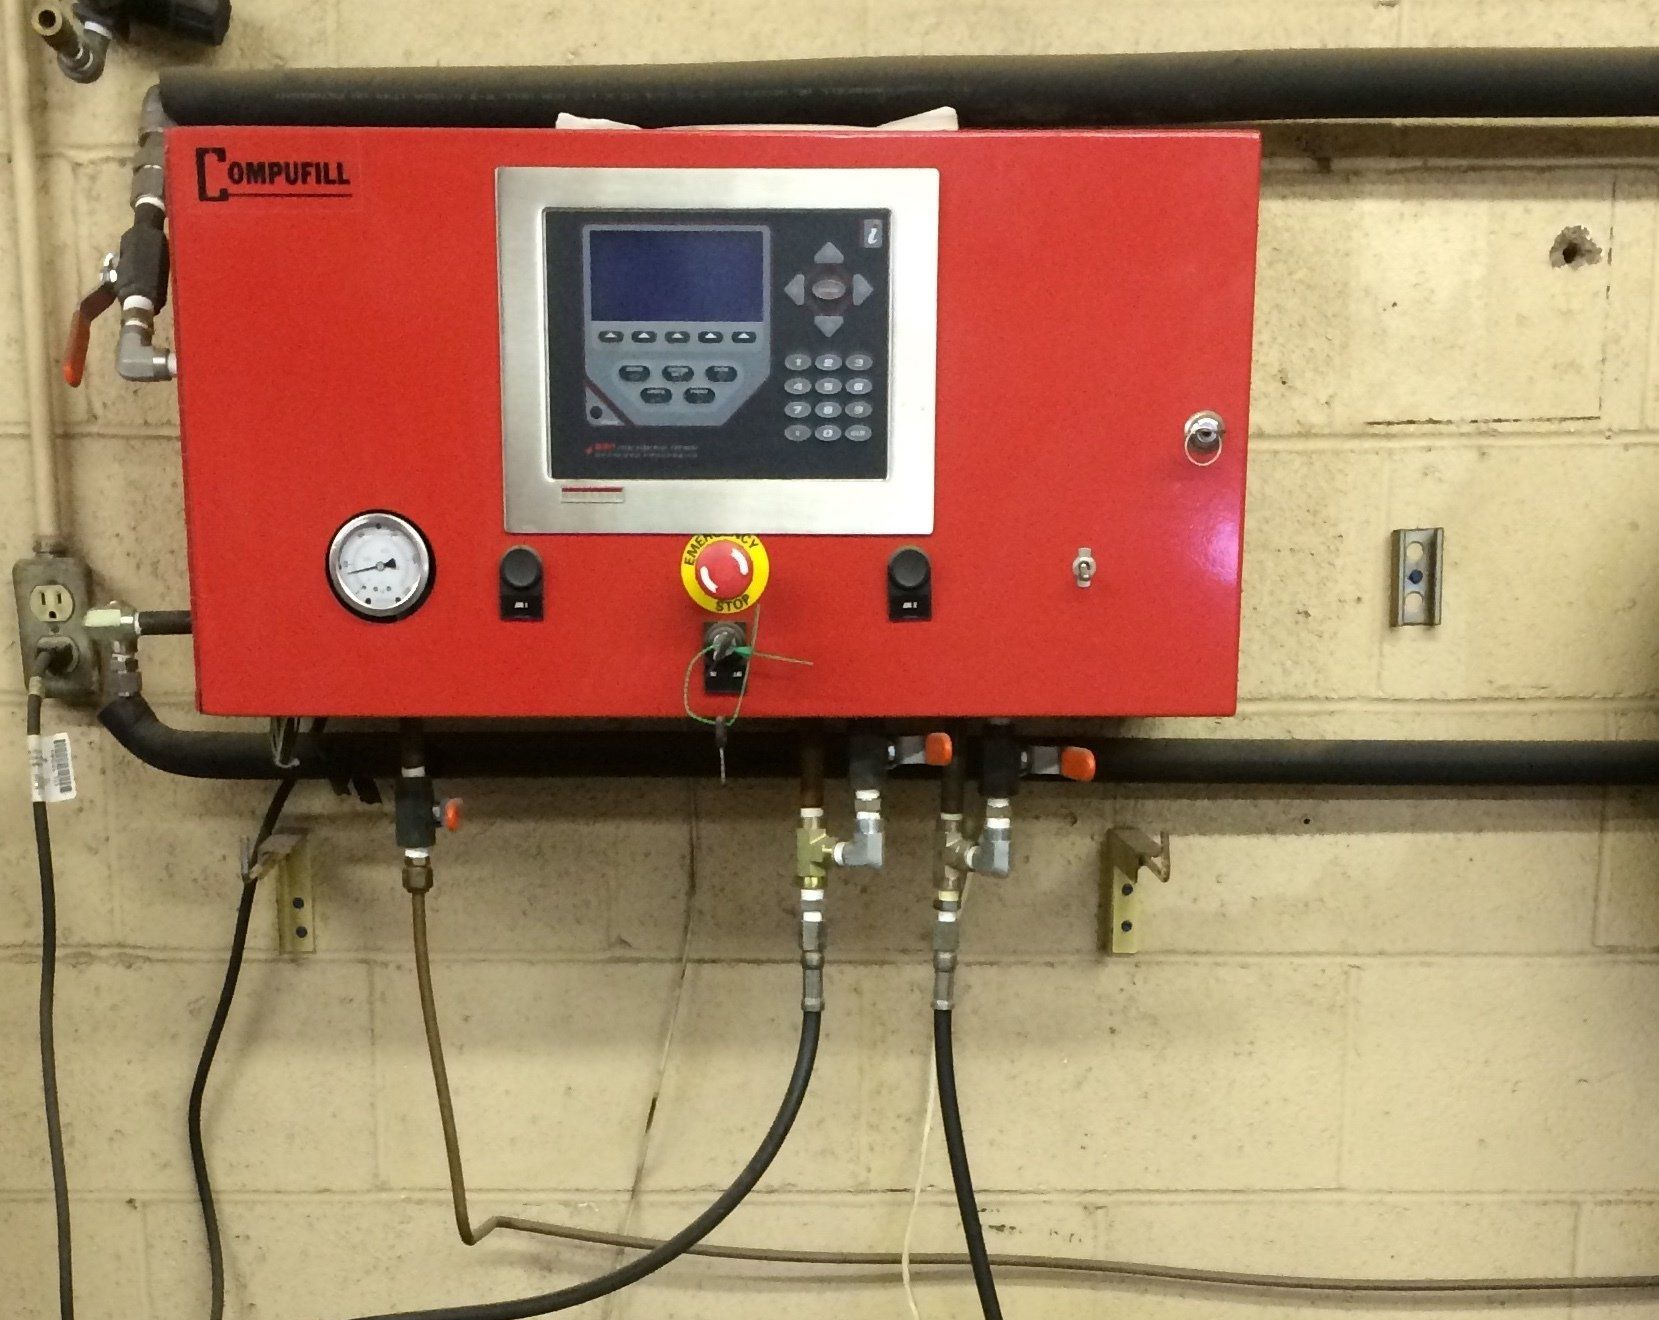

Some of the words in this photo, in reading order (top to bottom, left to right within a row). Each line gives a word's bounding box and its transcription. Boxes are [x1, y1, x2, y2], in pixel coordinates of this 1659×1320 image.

[196, 147, 351, 202] COMPUFILL
[823, 358, 834, 367] 2
[715, 594, 750, 612] STOP
